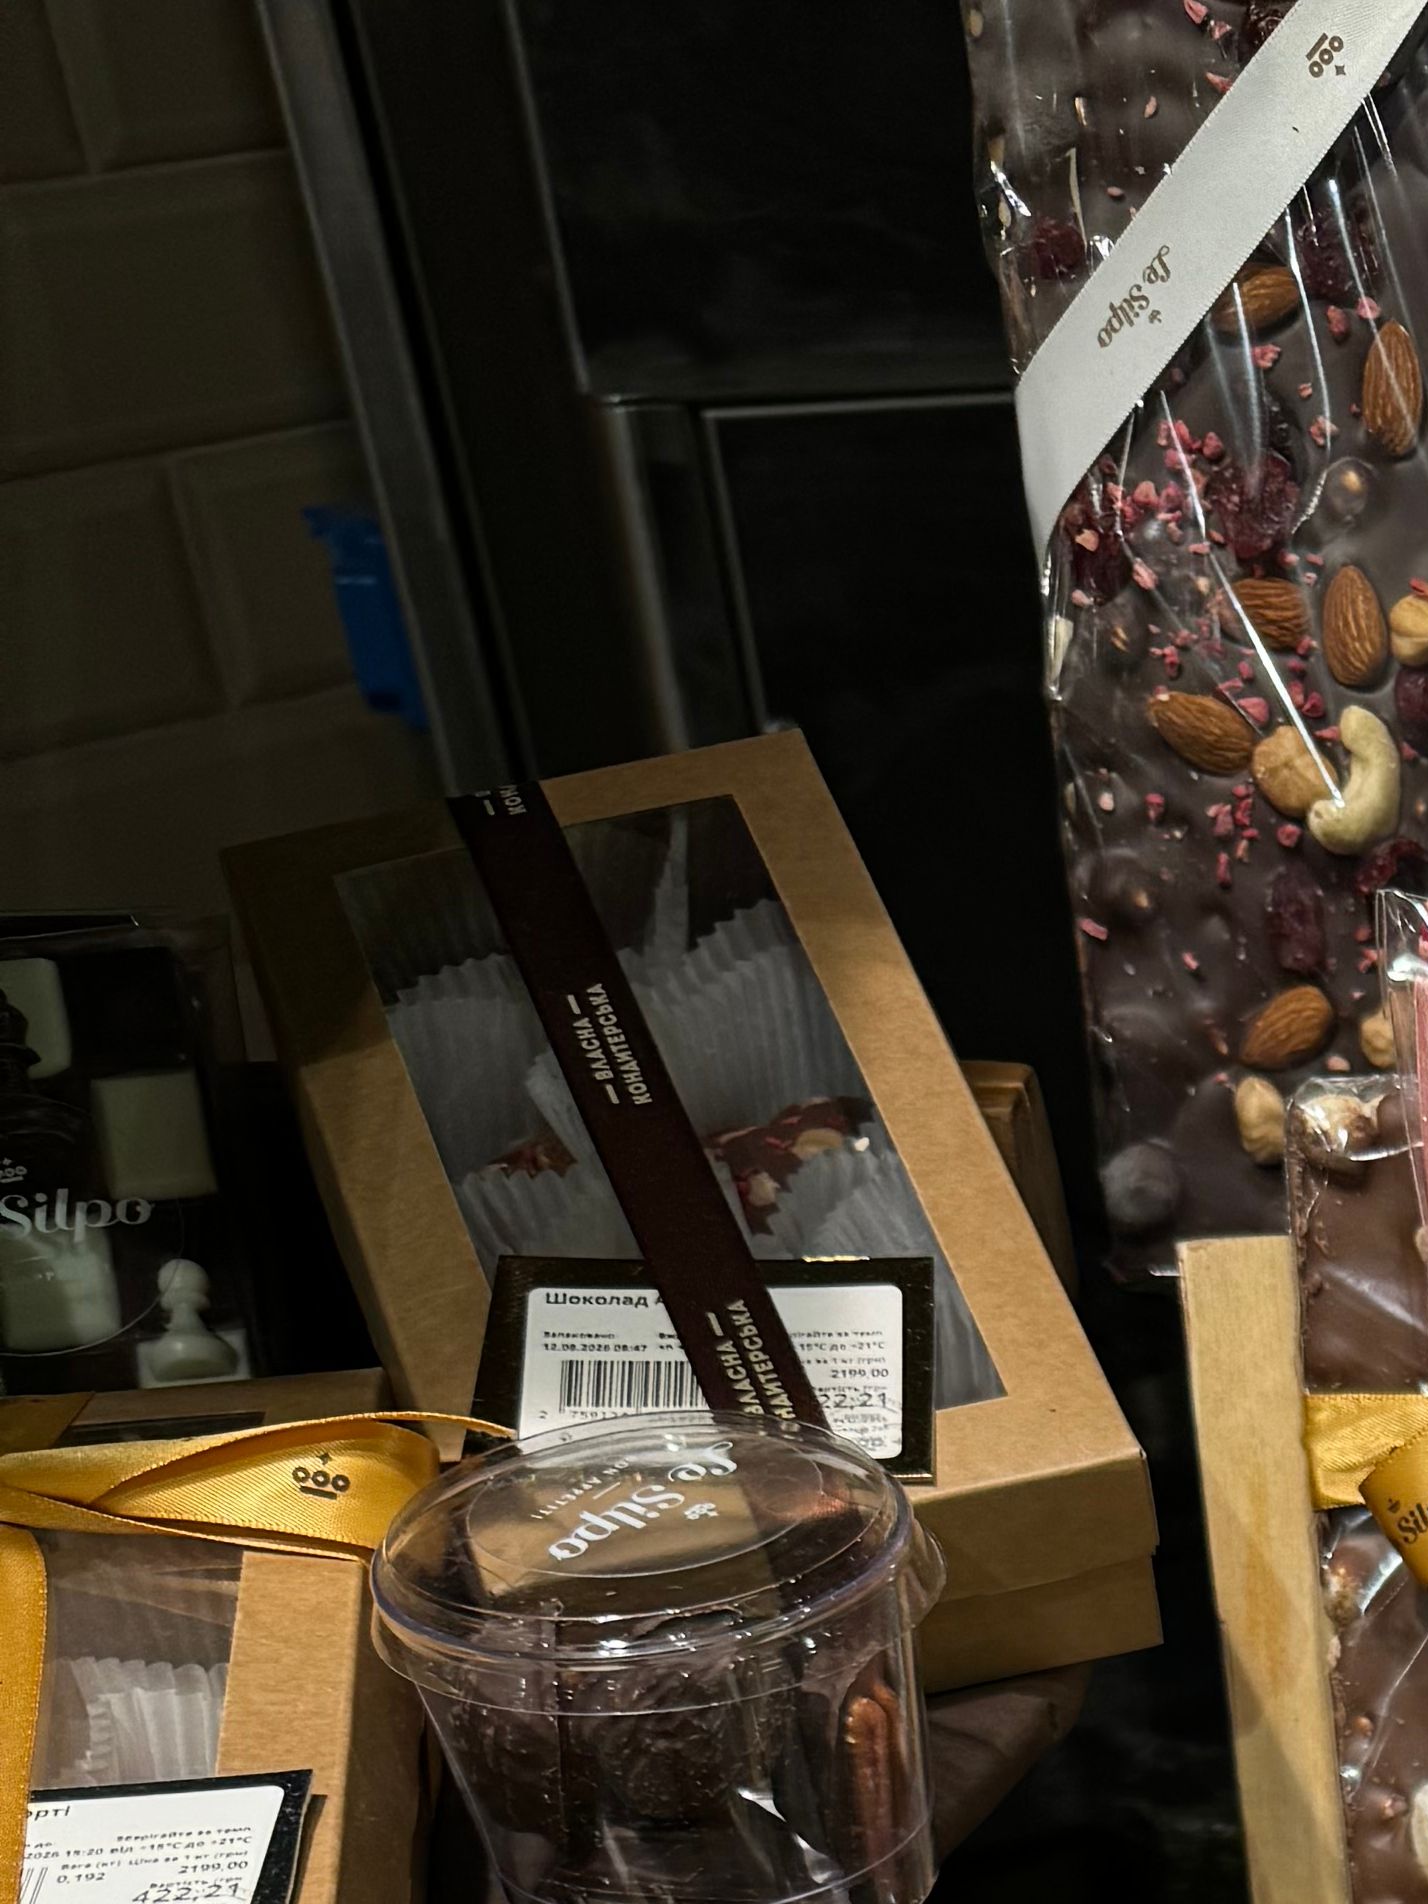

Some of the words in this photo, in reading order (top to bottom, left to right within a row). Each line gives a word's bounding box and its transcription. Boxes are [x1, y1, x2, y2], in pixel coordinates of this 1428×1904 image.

[1142, 244, 1170, 284] Le
[1097, 284, 1150, 348] Silpo
[573, 1017, 613, 1081] ВЛАСНА
[587, 983, 652, 1104] КОНДИТЕРСЬКА
[0, 1188, 154, 1243] Silpo
[545, 1292, 649, 1308] Шоколад
[548, 1484, 686, 1561] Silpo
